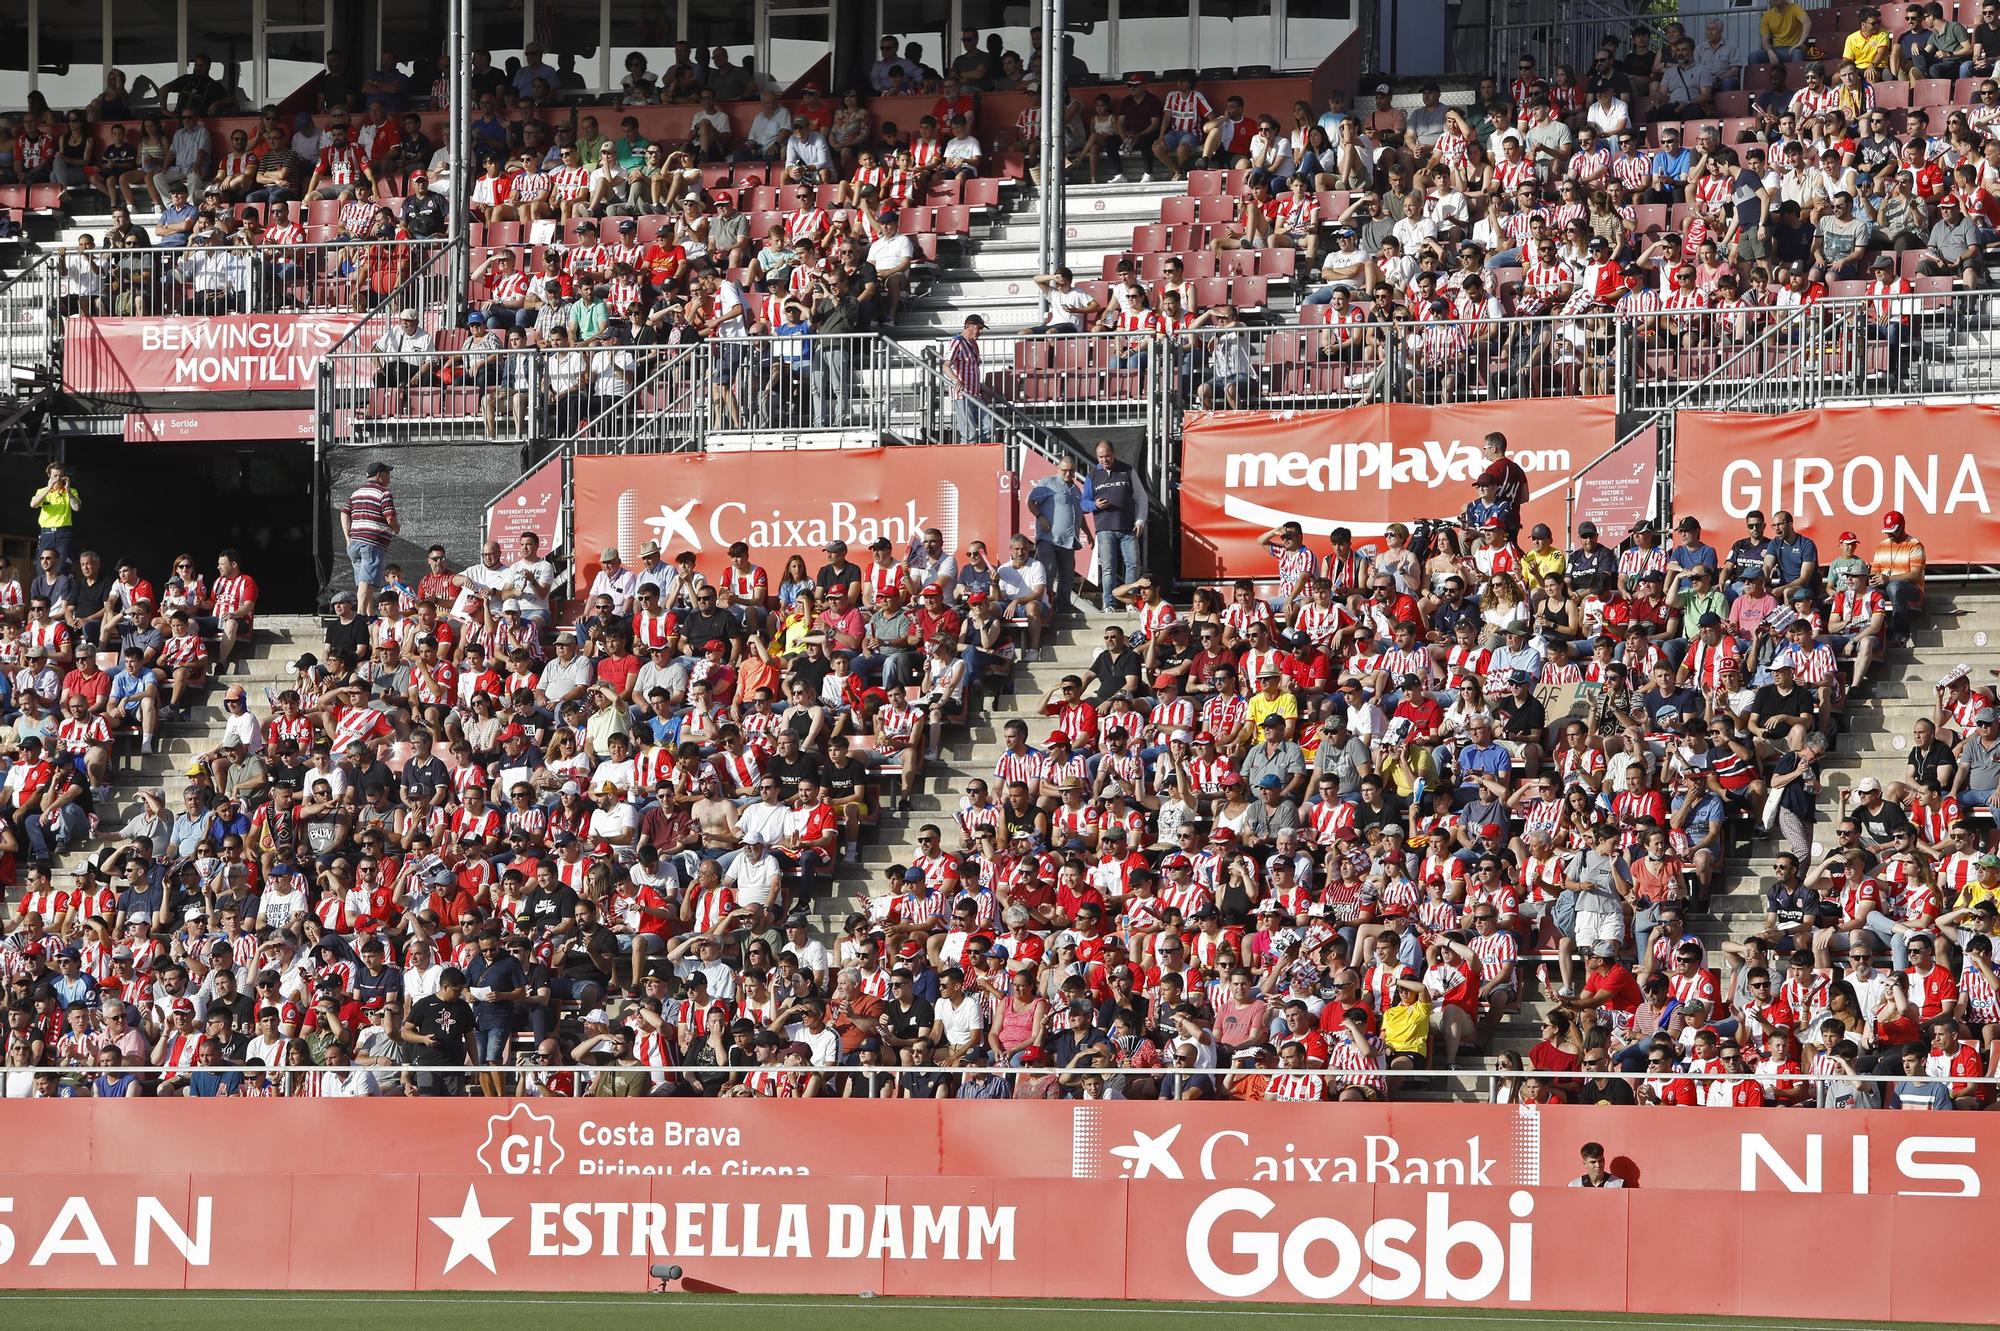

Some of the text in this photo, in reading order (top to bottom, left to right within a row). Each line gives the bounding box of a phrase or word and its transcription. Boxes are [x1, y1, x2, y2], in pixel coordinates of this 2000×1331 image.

[143, 323, 331, 350] BENVINGUTS
[176, 355, 326, 382] MONTILIV
[171, 419, 198, 428] Sortida
[297, 425, 315, 433] Sort
[1000, 475, 1009, 488] C
[1721, 454, 1991, 518] GIRONA
[710, 500, 929, 548] CaixaBank
[309, 827, 333, 841] BKLYN
[318, 839, 325, 852] 7
[579, 1121, 741, 1147] Costa Brava
[501, 1135, 543, 1175] G!
[1200, 1130, 1497, 1187] CaixaBank
[1741, 1133, 1981, 1197] NIS
[0, 1196, 213, 1267] AN
[529, 1203, 1017, 1261] ESTRELLA DAMM
[1186, 1187, 1535, 1301] Gosbi
